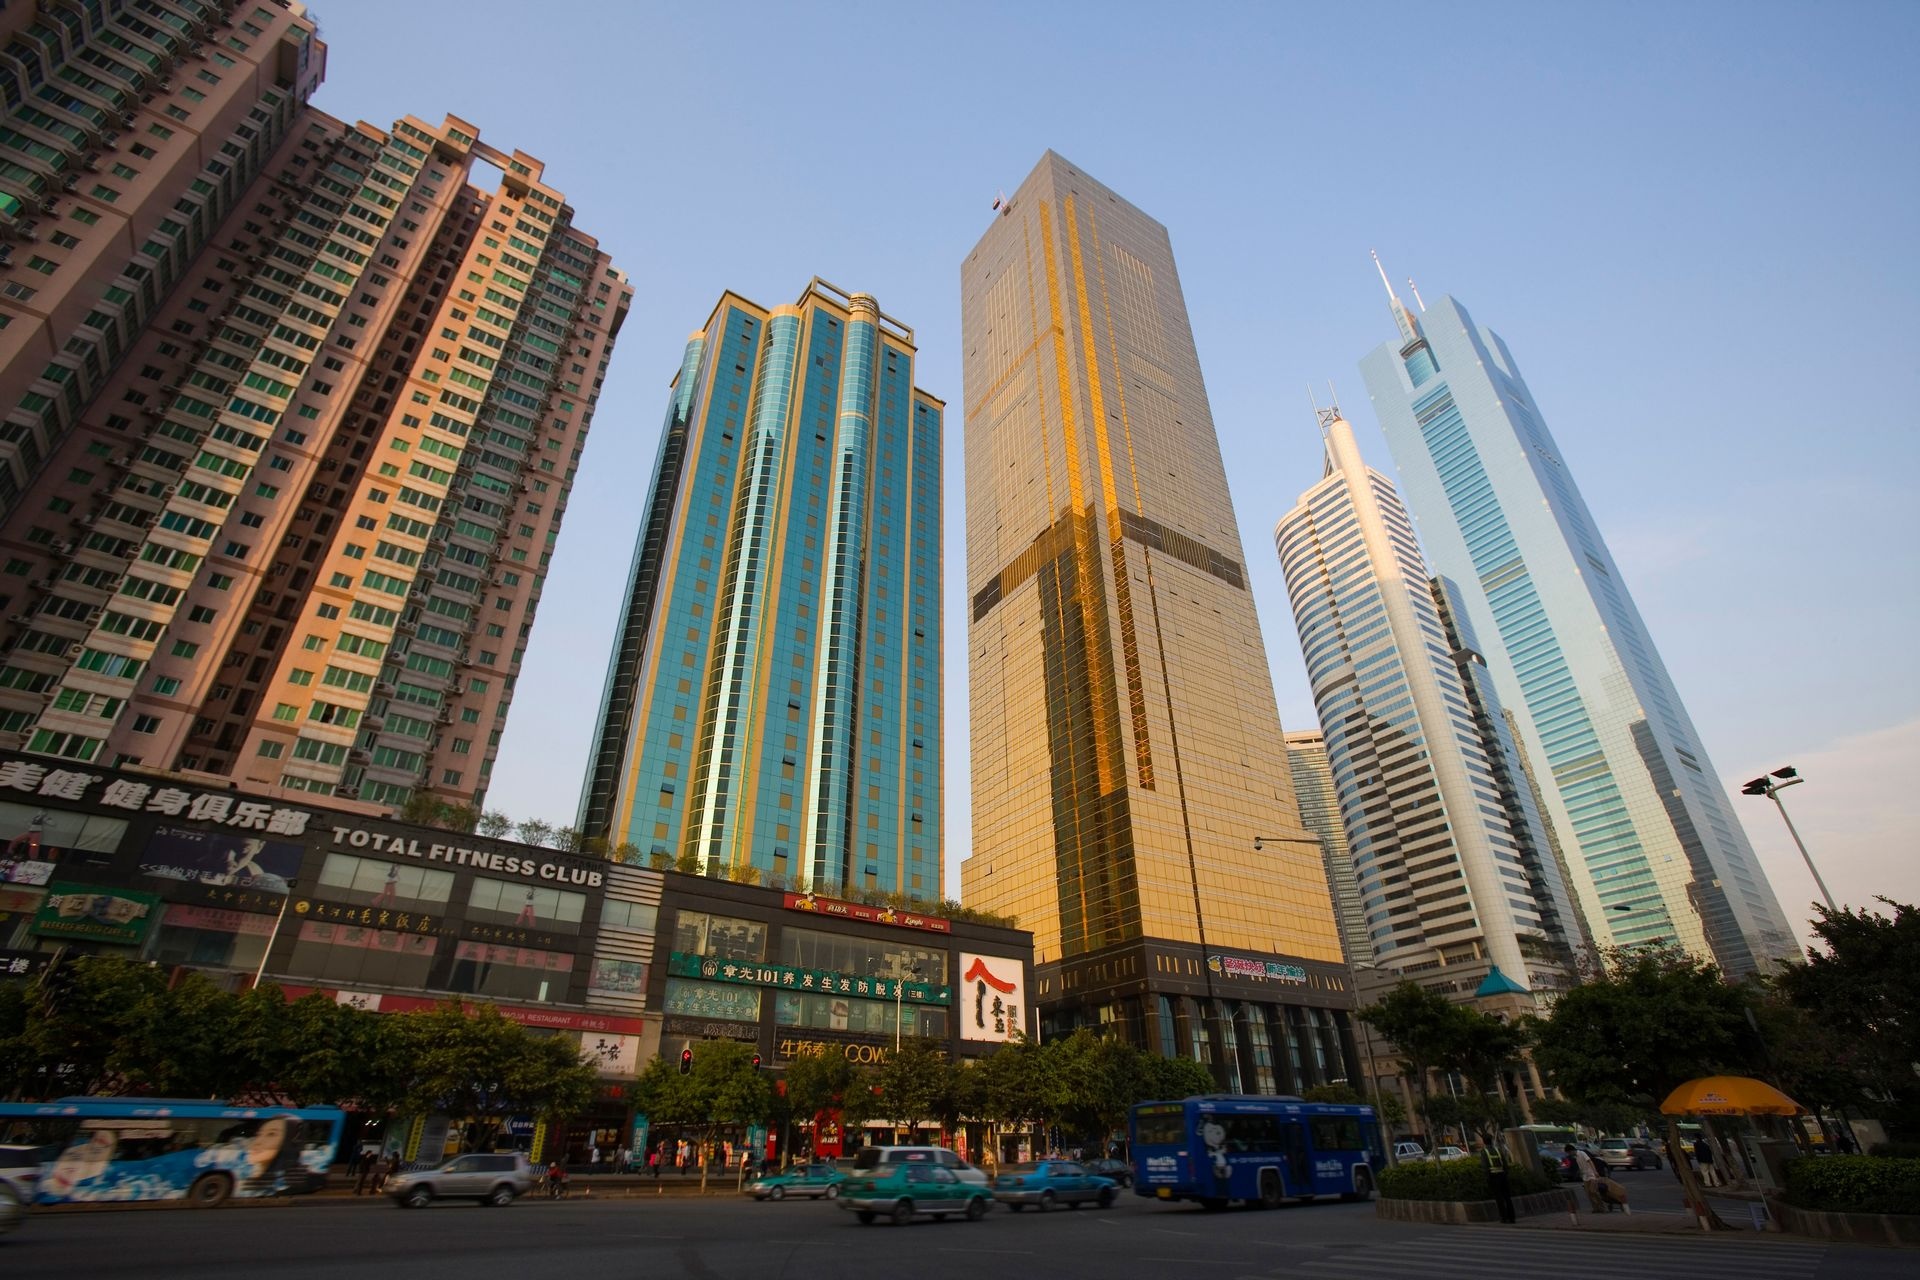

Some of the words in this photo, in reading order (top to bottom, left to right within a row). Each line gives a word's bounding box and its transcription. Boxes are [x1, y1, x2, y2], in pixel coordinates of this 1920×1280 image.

[100, 778, 310, 836] 健身俱乐部
[332, 826, 422, 859] TOTAL
[428, 844, 536, 877] FITNESS
[540, 863, 604, 888] CLUB
[1224, 957, 1266, 975] 圣诞快乐
[527, 1014, 572, 1025] RESTAURANT
